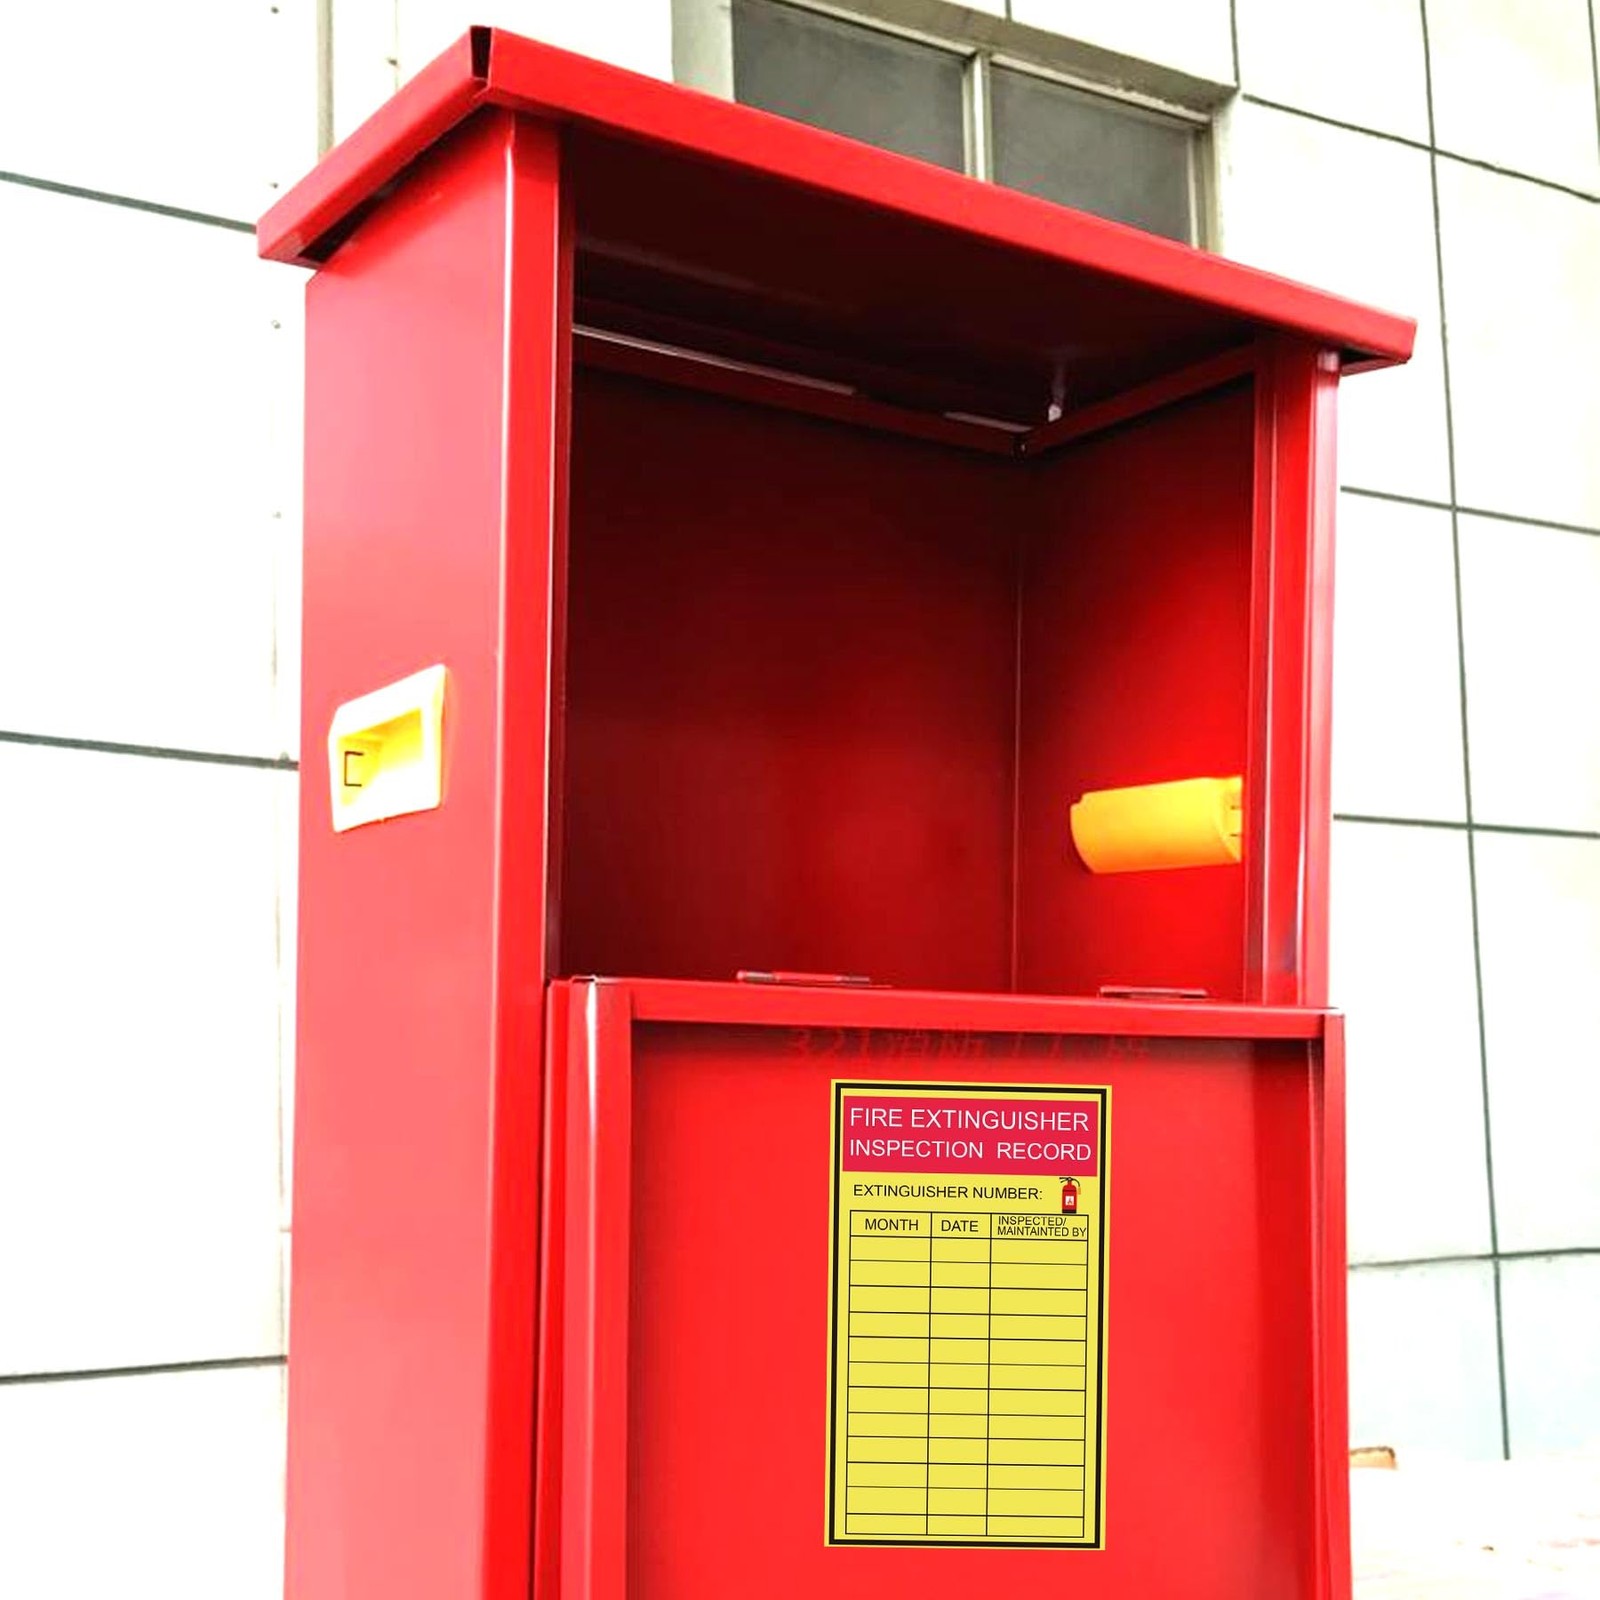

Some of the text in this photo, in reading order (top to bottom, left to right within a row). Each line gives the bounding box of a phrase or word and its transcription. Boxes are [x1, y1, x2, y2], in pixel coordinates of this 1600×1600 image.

[850, 1108, 1089, 1131] FIRE EXTINGUISHER
[850, 1139, 1091, 1160] INSPECTION RECORD
[854, 1185, 1042, 1200] EXTINGUISHER NUMBER:
[865, 1219, 918, 1231] MONTH
[941, 1220, 979, 1232] DATE
[998, 1216, 1066, 1226] INSPECTED/
[998, 1226, 1086, 1237] MAINTAINTED BY
